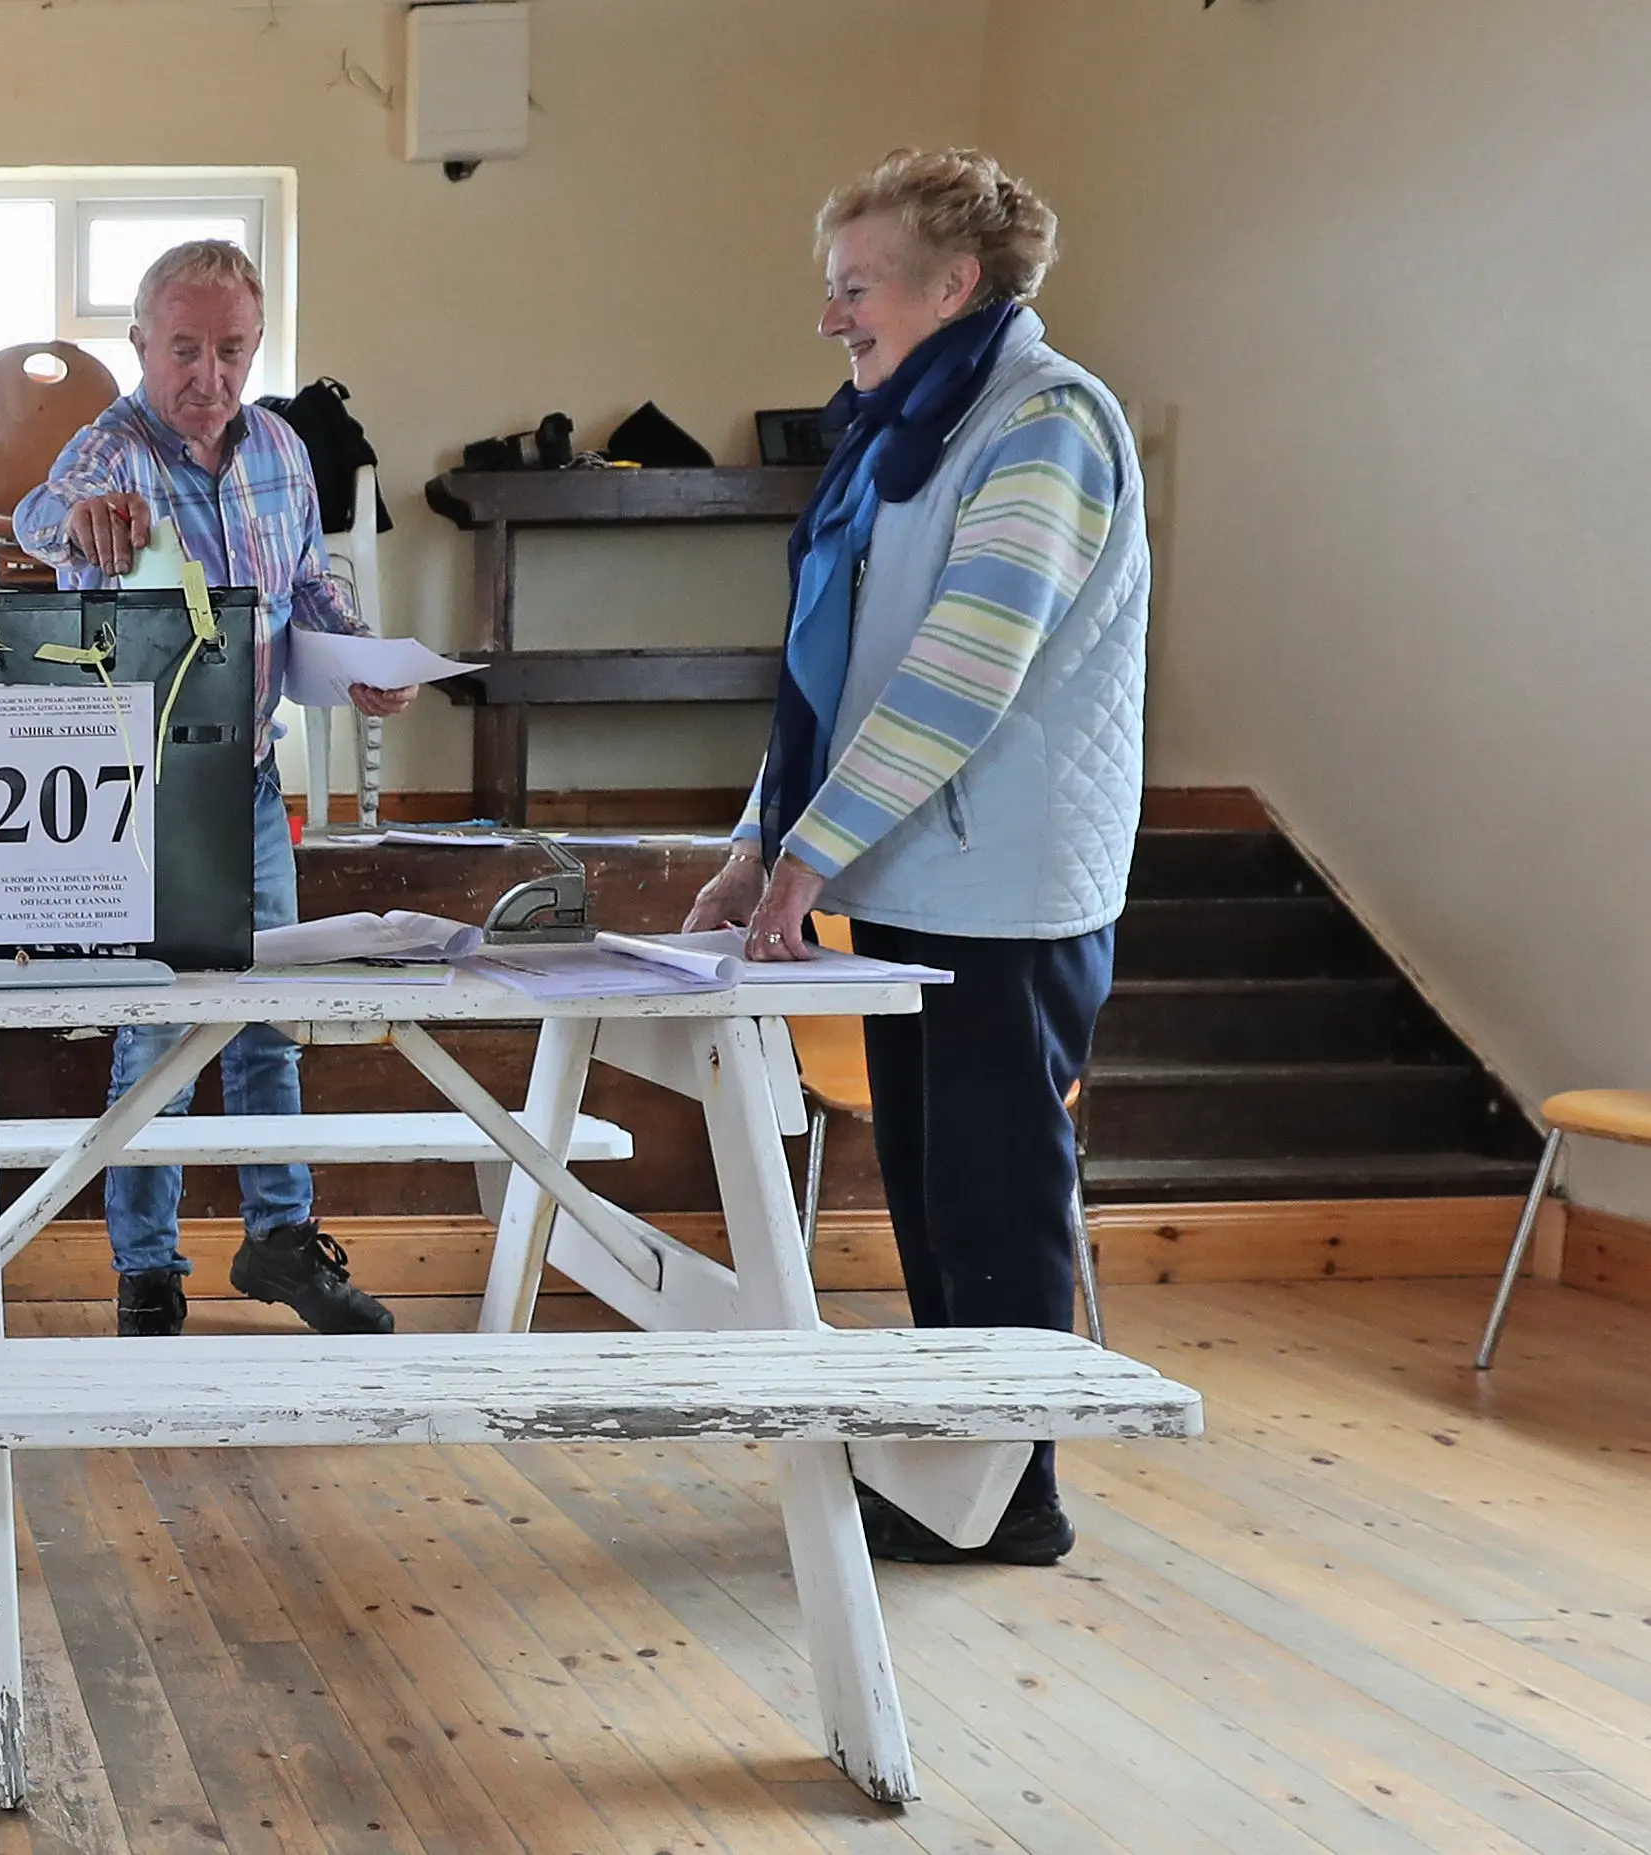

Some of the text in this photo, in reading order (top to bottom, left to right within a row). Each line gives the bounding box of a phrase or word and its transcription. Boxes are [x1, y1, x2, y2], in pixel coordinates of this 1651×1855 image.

[10, 722, 117, 737] UIMHIR STAISIÚIN
[0, 912, 38, 921] CARMEL
[56, 911, 93, 920] GIOLLA
